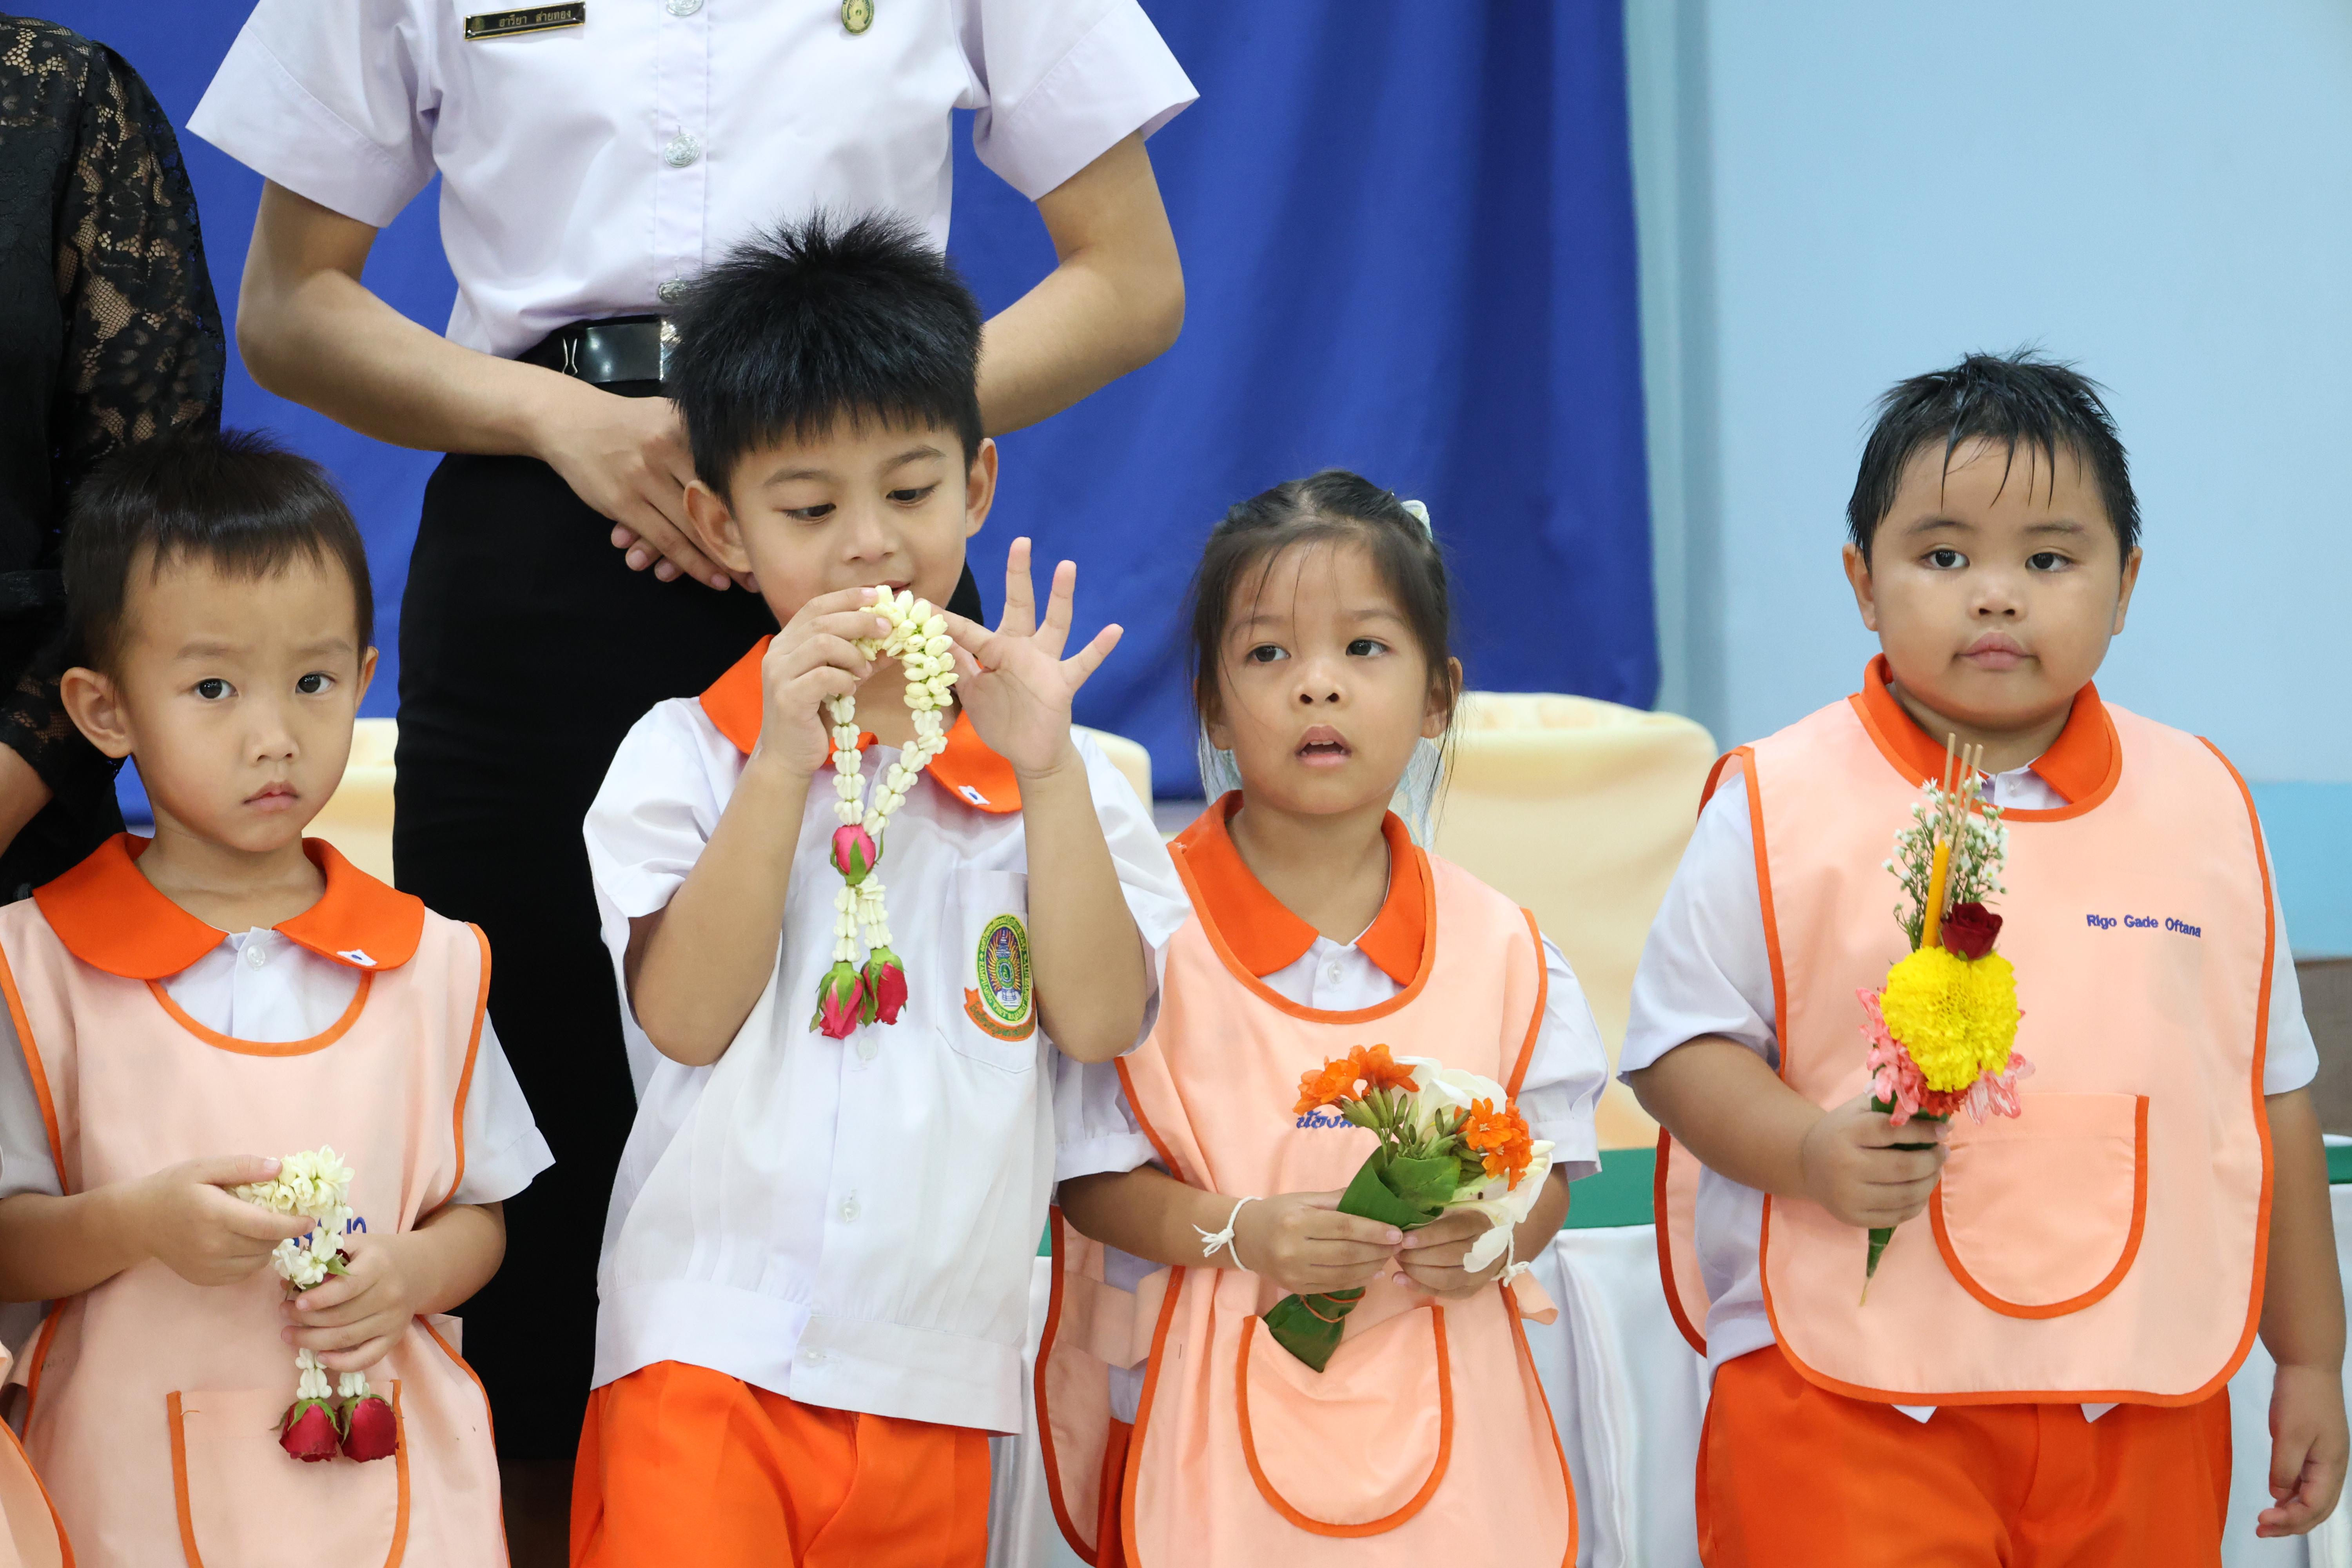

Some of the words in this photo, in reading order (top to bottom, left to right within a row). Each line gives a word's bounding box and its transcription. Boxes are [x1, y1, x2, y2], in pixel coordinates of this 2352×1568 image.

[2086, 914, 2117, 929] Rigo
[2124, 914, 2159, 928] Gade
[2165, 917, 2201, 938] Oftana
